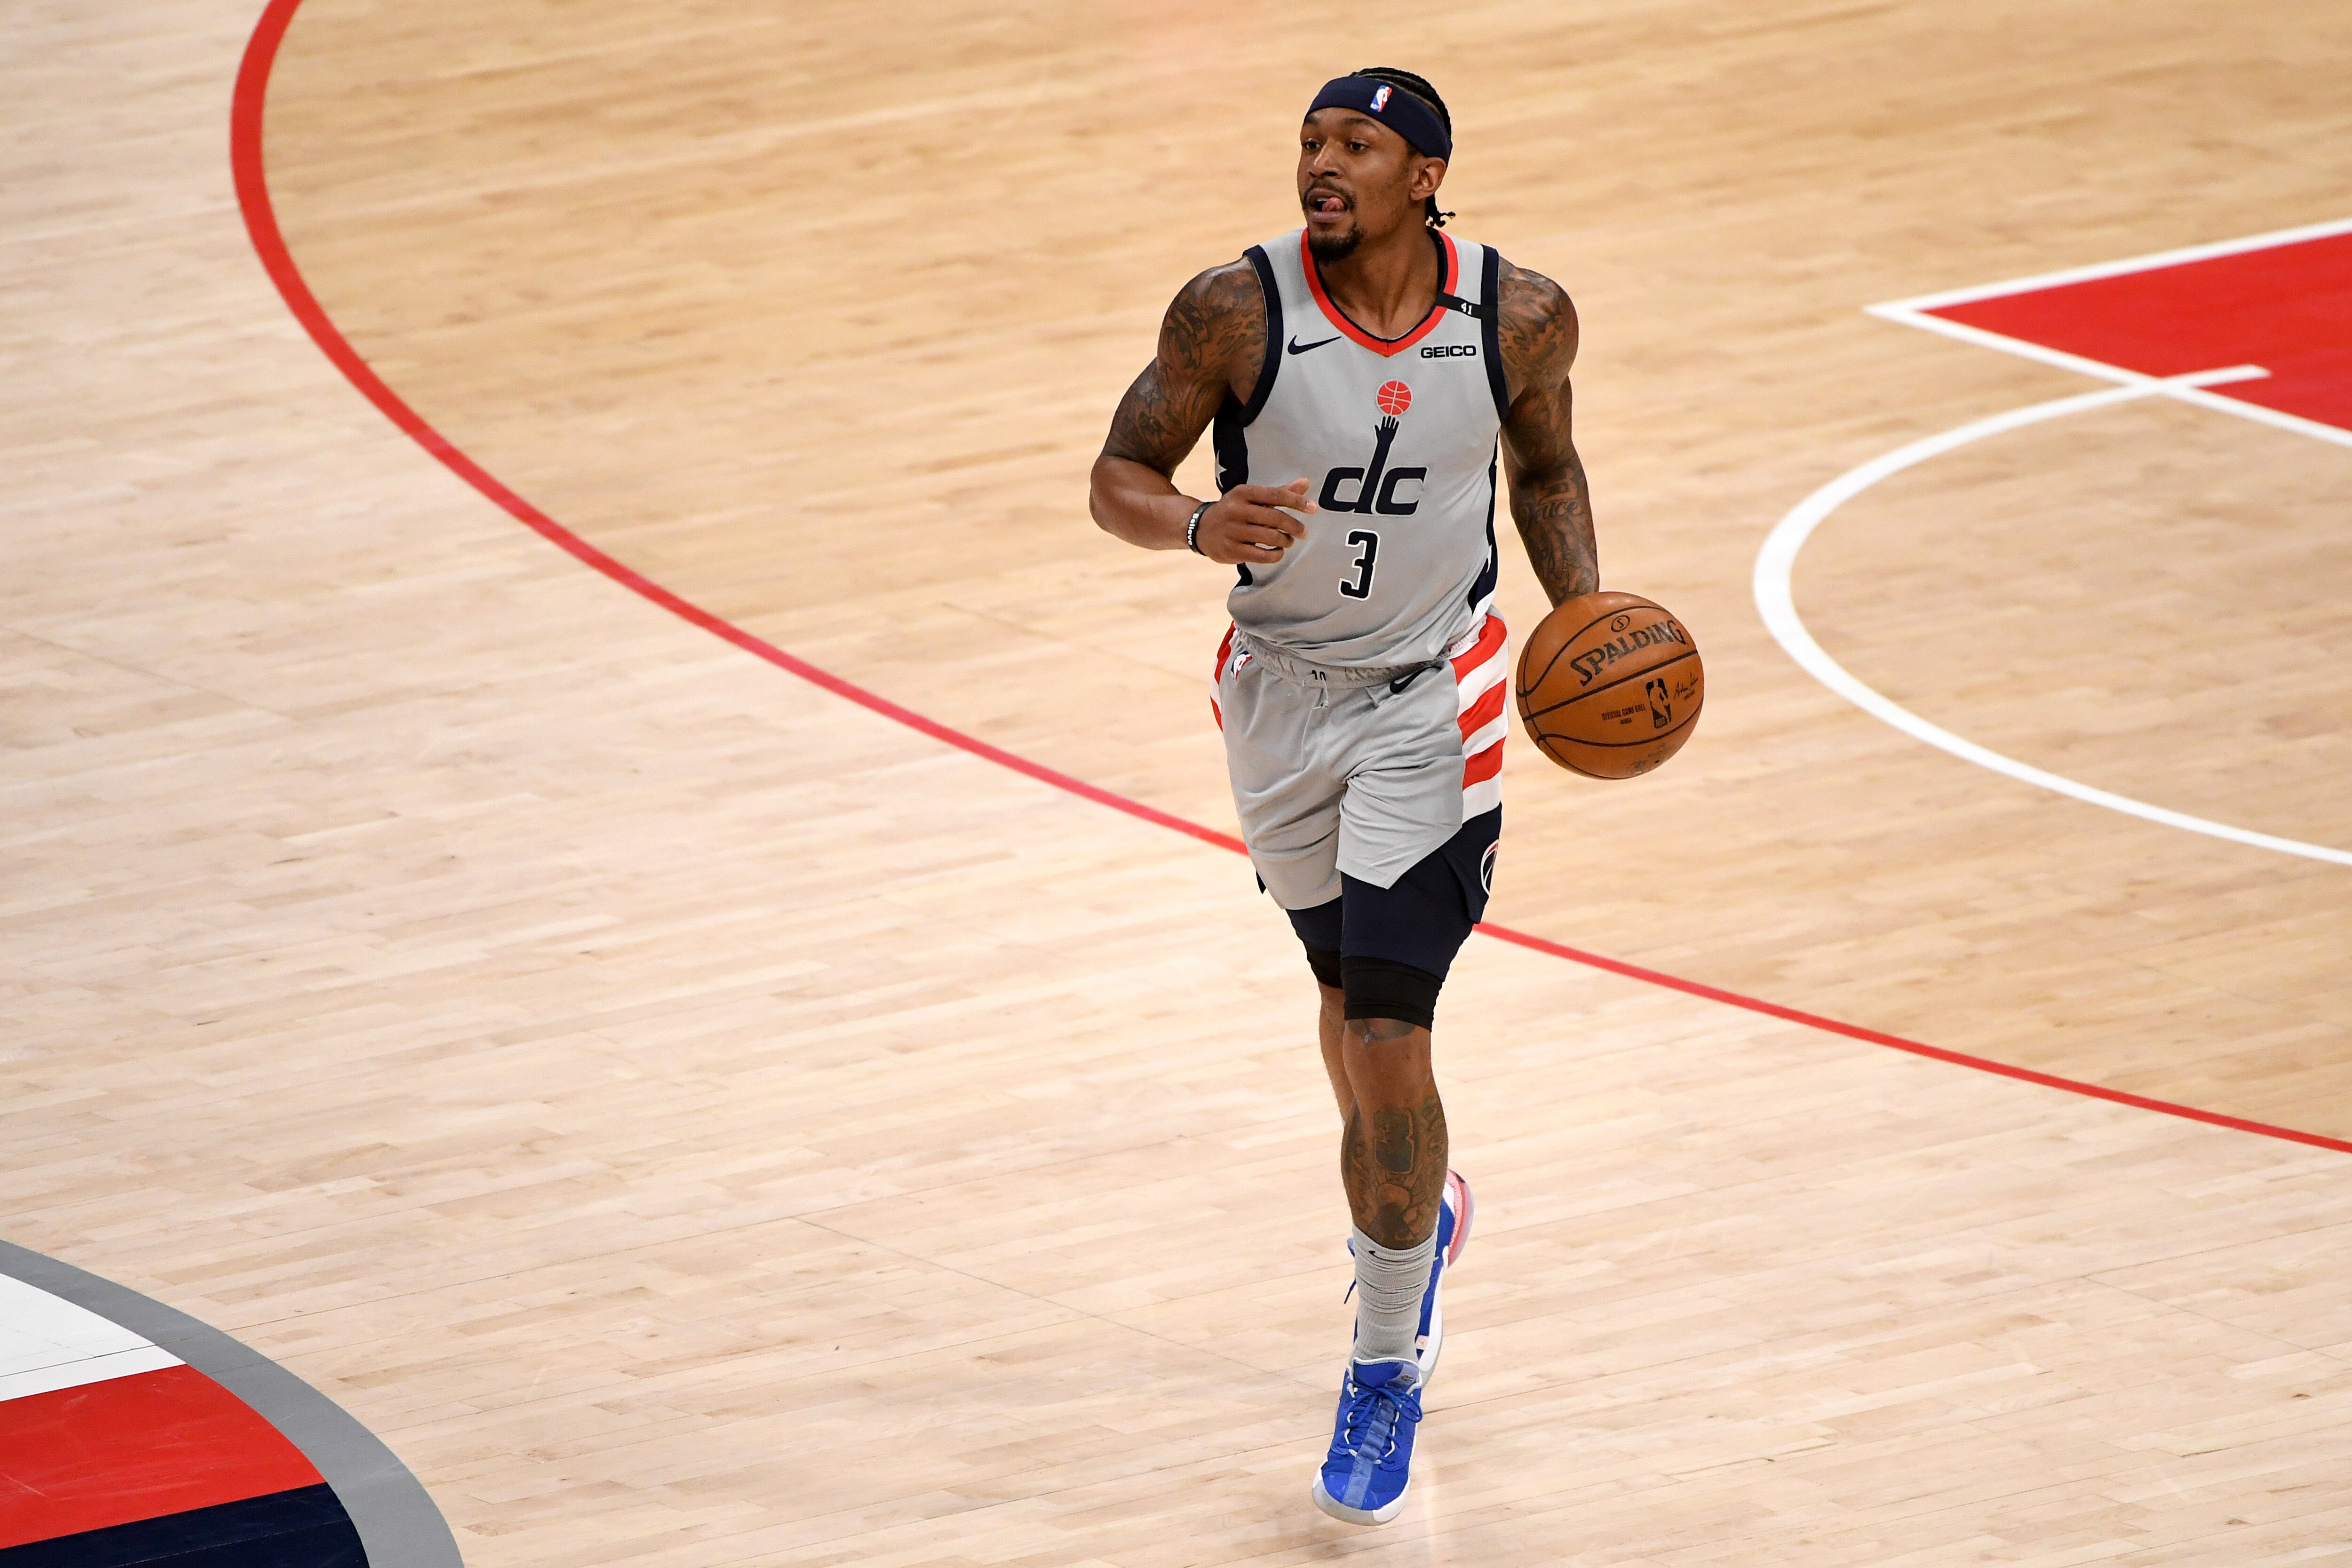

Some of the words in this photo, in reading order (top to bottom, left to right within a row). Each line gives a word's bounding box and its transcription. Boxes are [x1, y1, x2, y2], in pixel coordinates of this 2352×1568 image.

[1461, 302, 1472, 315] 41
[1420, 344, 1477, 359] GEICO
[1338, 528, 1381, 602] 3
[1570, 620, 1687, 687] SPALDING
